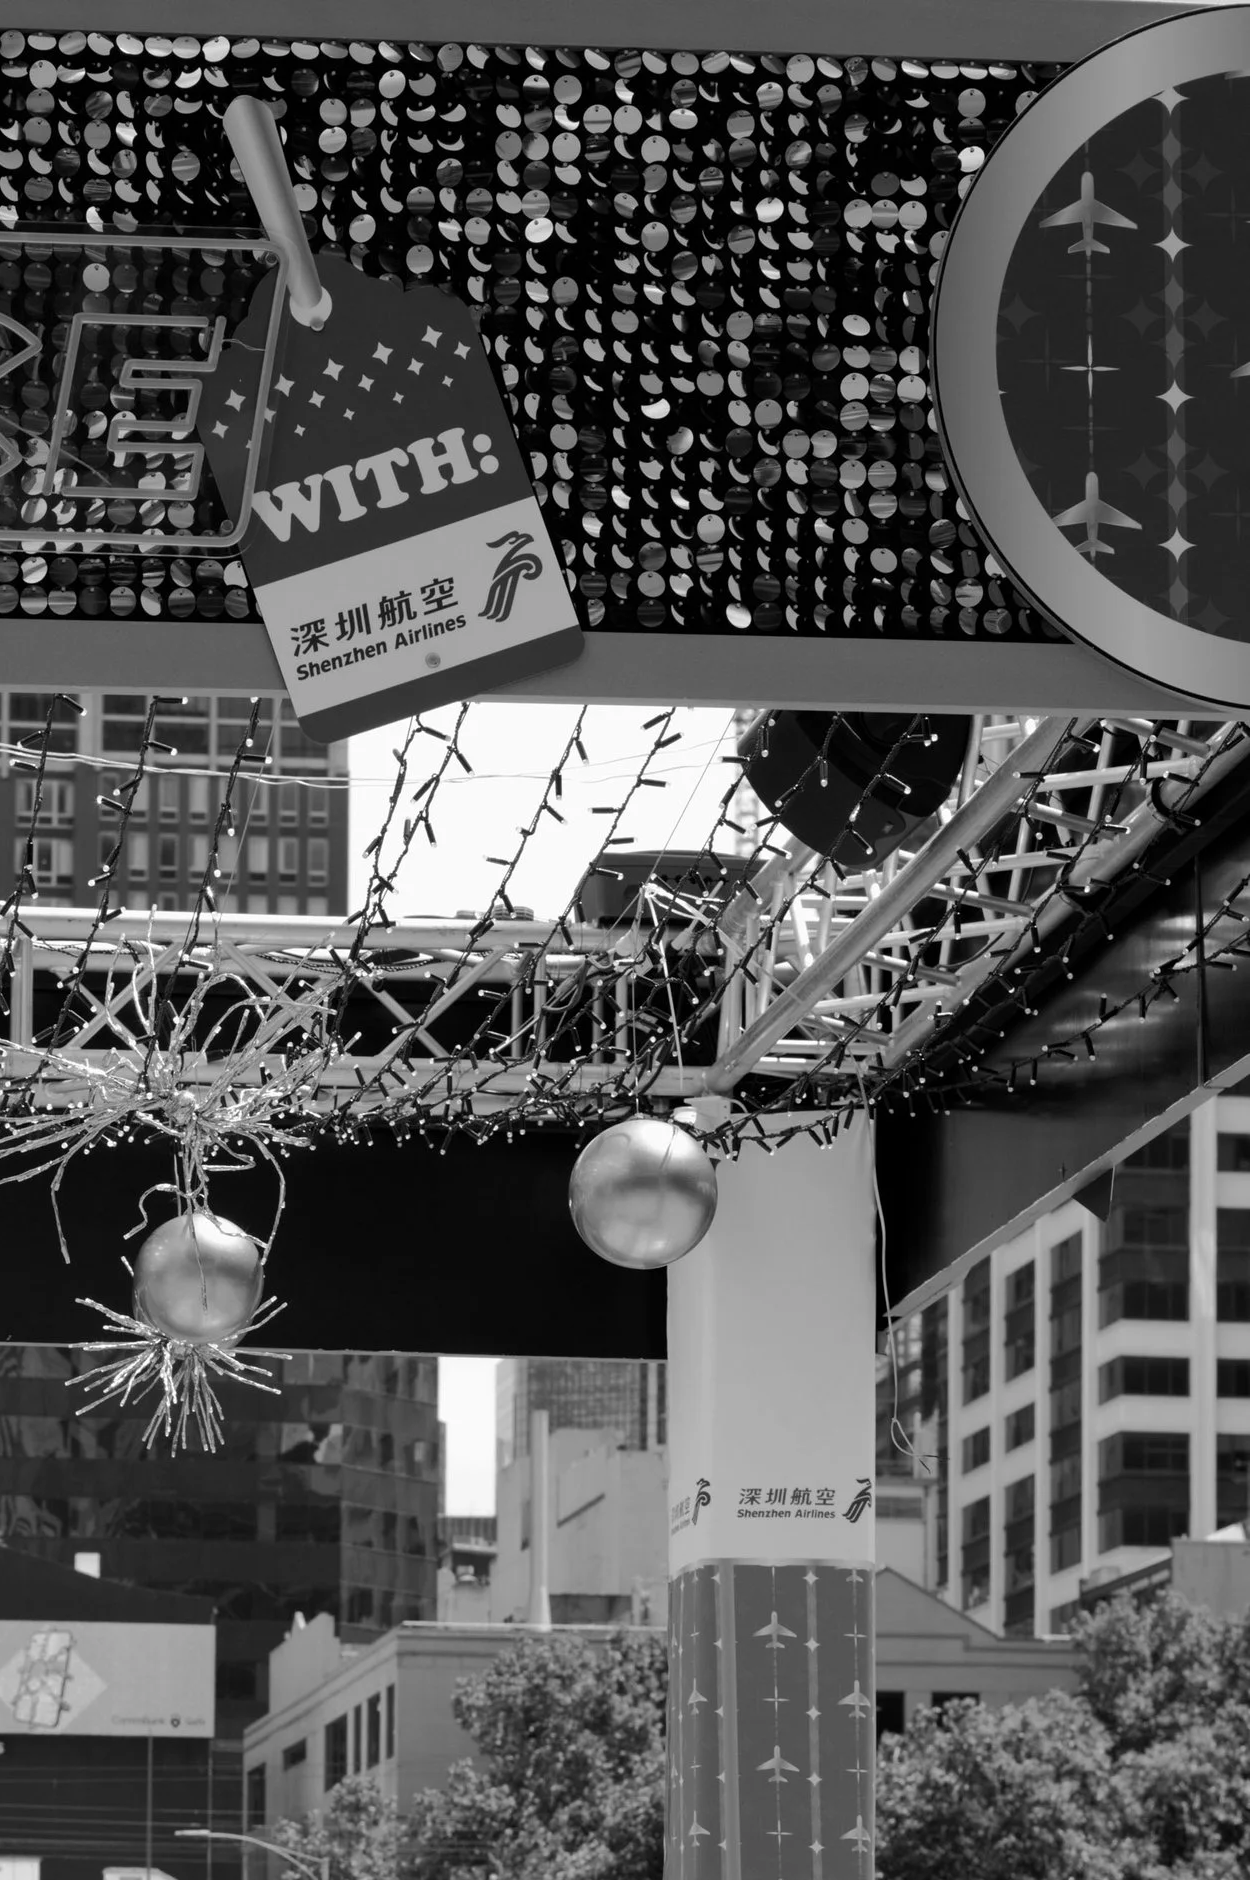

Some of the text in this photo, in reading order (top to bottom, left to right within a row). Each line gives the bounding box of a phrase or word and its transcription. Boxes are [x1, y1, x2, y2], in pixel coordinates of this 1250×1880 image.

[250, 426, 500, 542] WITH:
[290, 577, 459, 657] 深圳航空
[296, 614, 467, 681] Shenzhen Airlines
[737, 1508, 836, 1519] Shenzhen Airlines
[738, 1487, 835, 1506] 深圳航空
